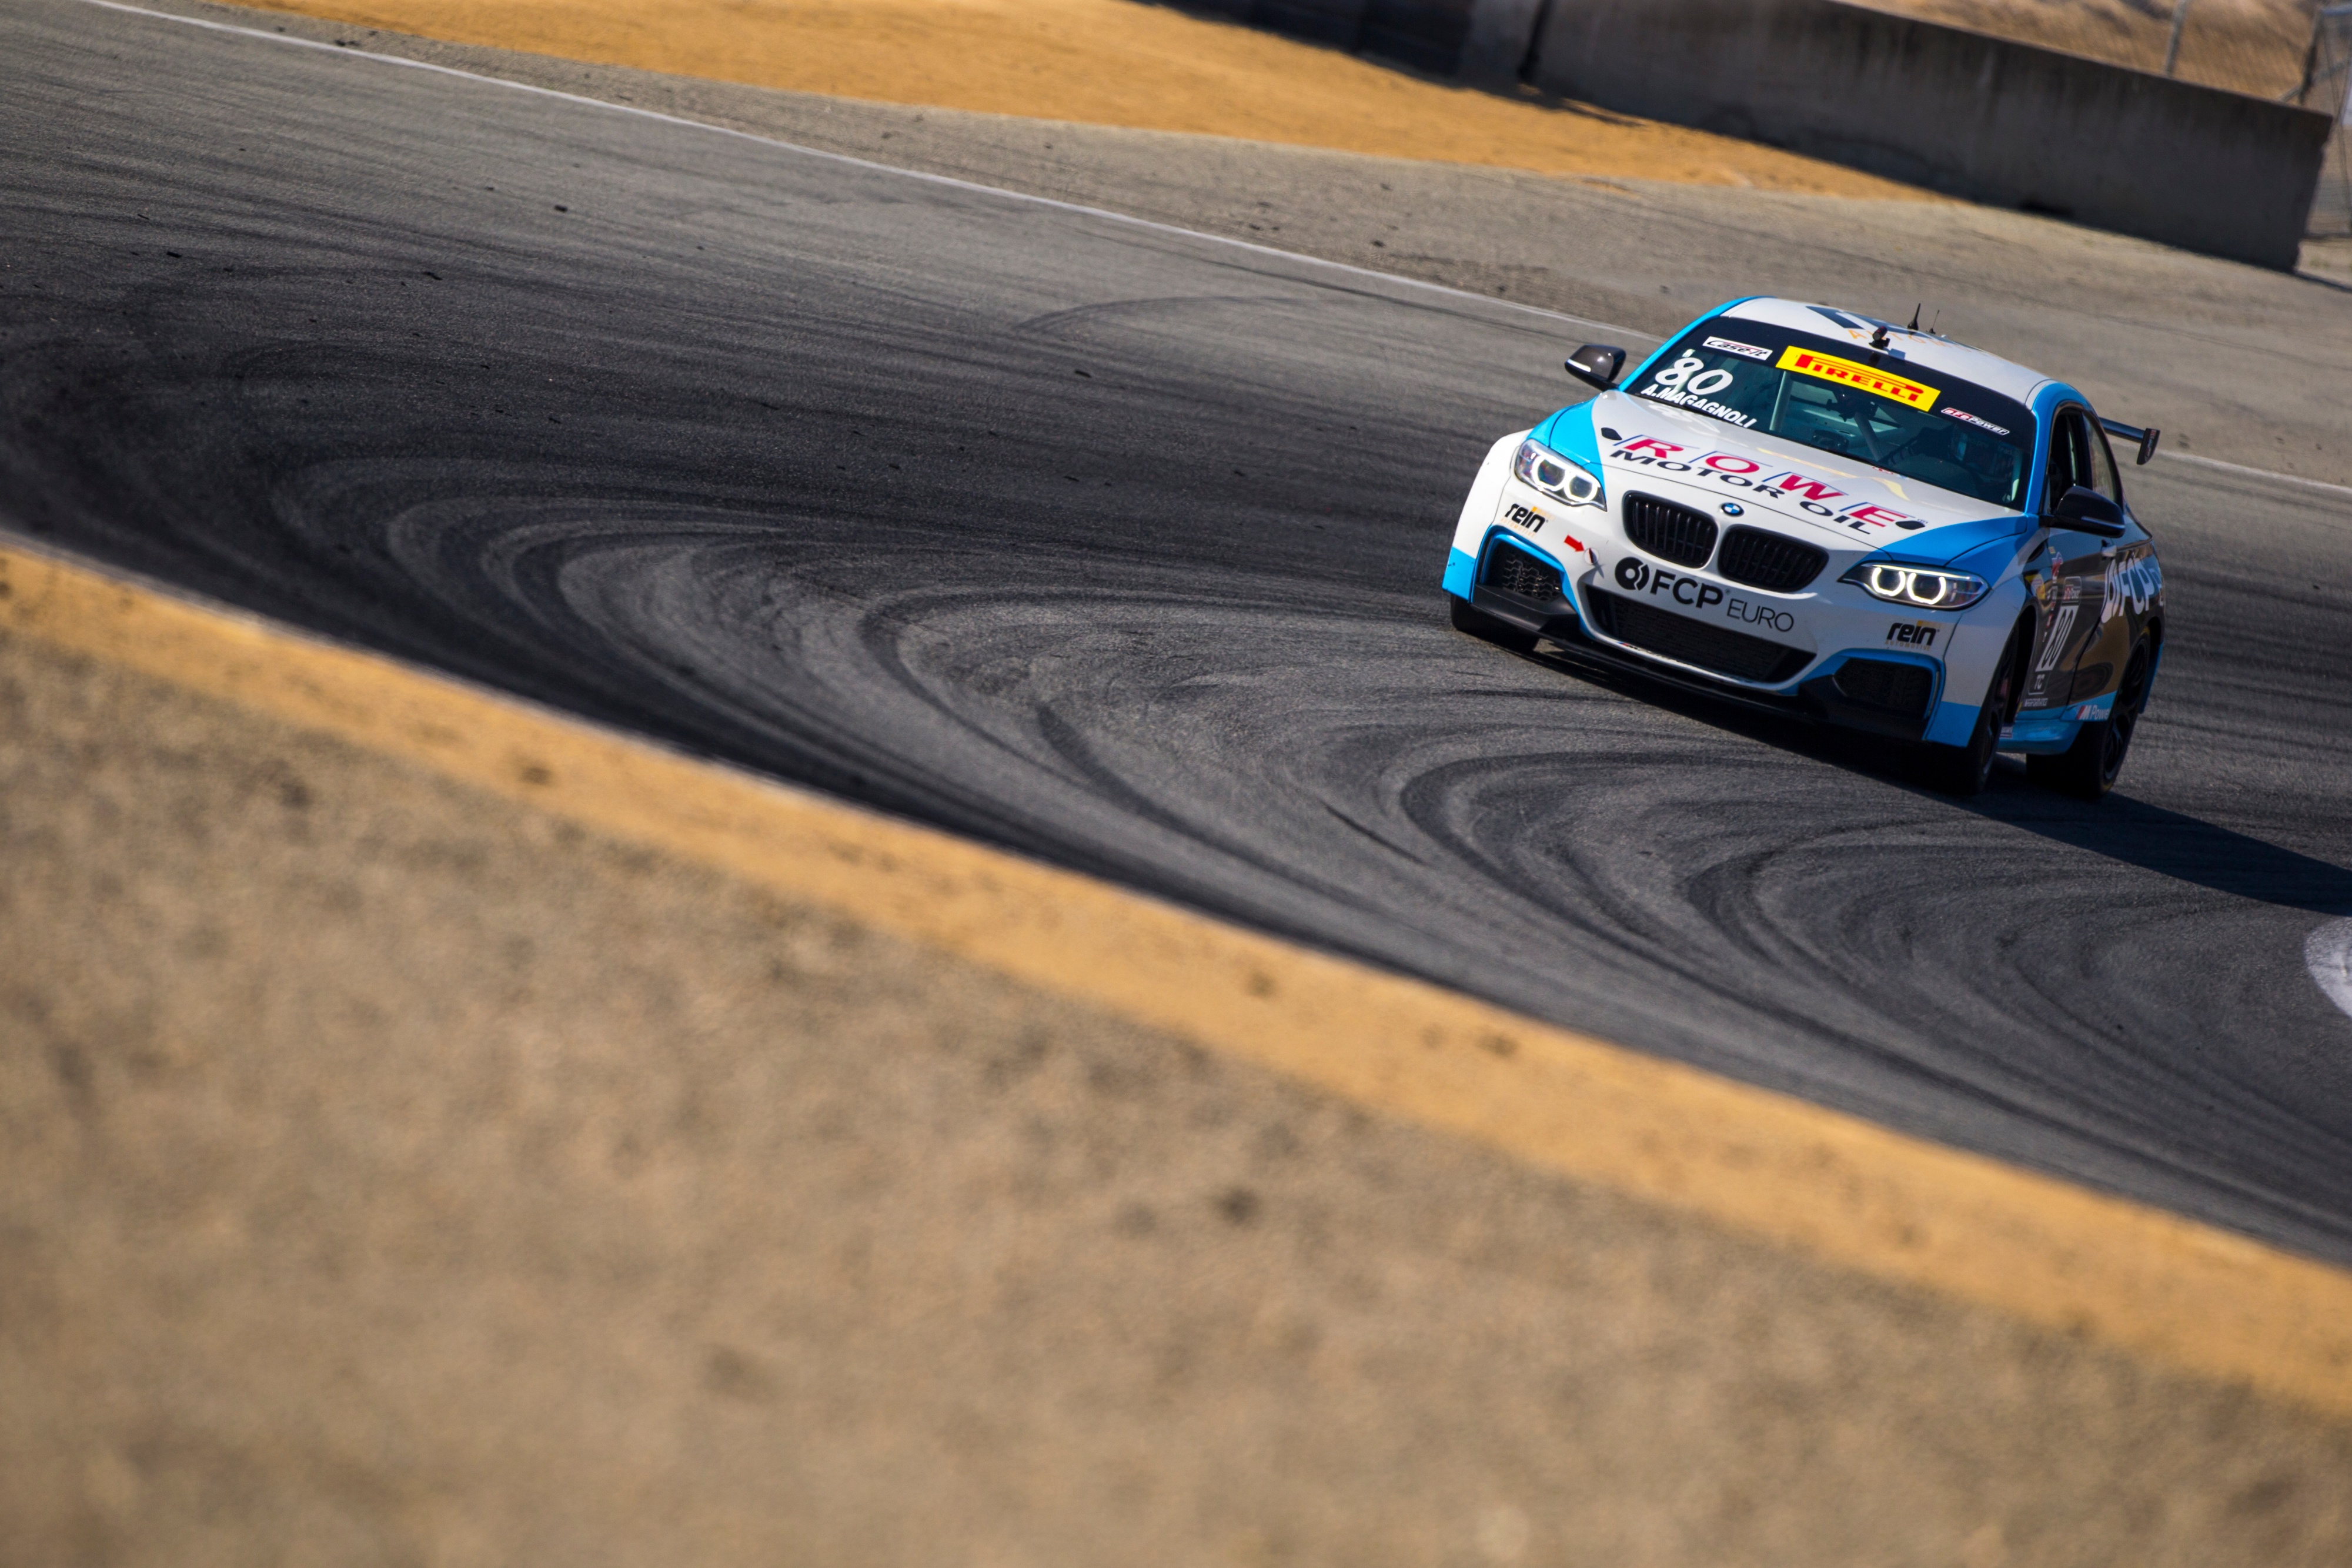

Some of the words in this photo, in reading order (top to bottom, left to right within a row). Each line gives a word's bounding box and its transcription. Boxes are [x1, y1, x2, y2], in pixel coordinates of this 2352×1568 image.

[1655, 357, 1733, 396] 80
[1795, 353, 1924, 402] PIRELLI
[1641, 383, 1758, 429] A.MAGAGNOLI
[1609, 449, 1786, 499] MOTOR
[1799, 501, 1872, 535] OIL
[1623, 437, 1907, 528] ROWE
[1505, 503, 1546, 533] rein
[1649, 569, 1723, 609] FCP
[1726, 598, 1795, 633] EURO
[2118, 556, 2155, 617] FCP
[1886, 620, 1936, 646] rein
[2042, 610, 2073, 669] 80
[2034, 674, 2046, 690] TC
[2090, 705, 2111, 720] Powe
